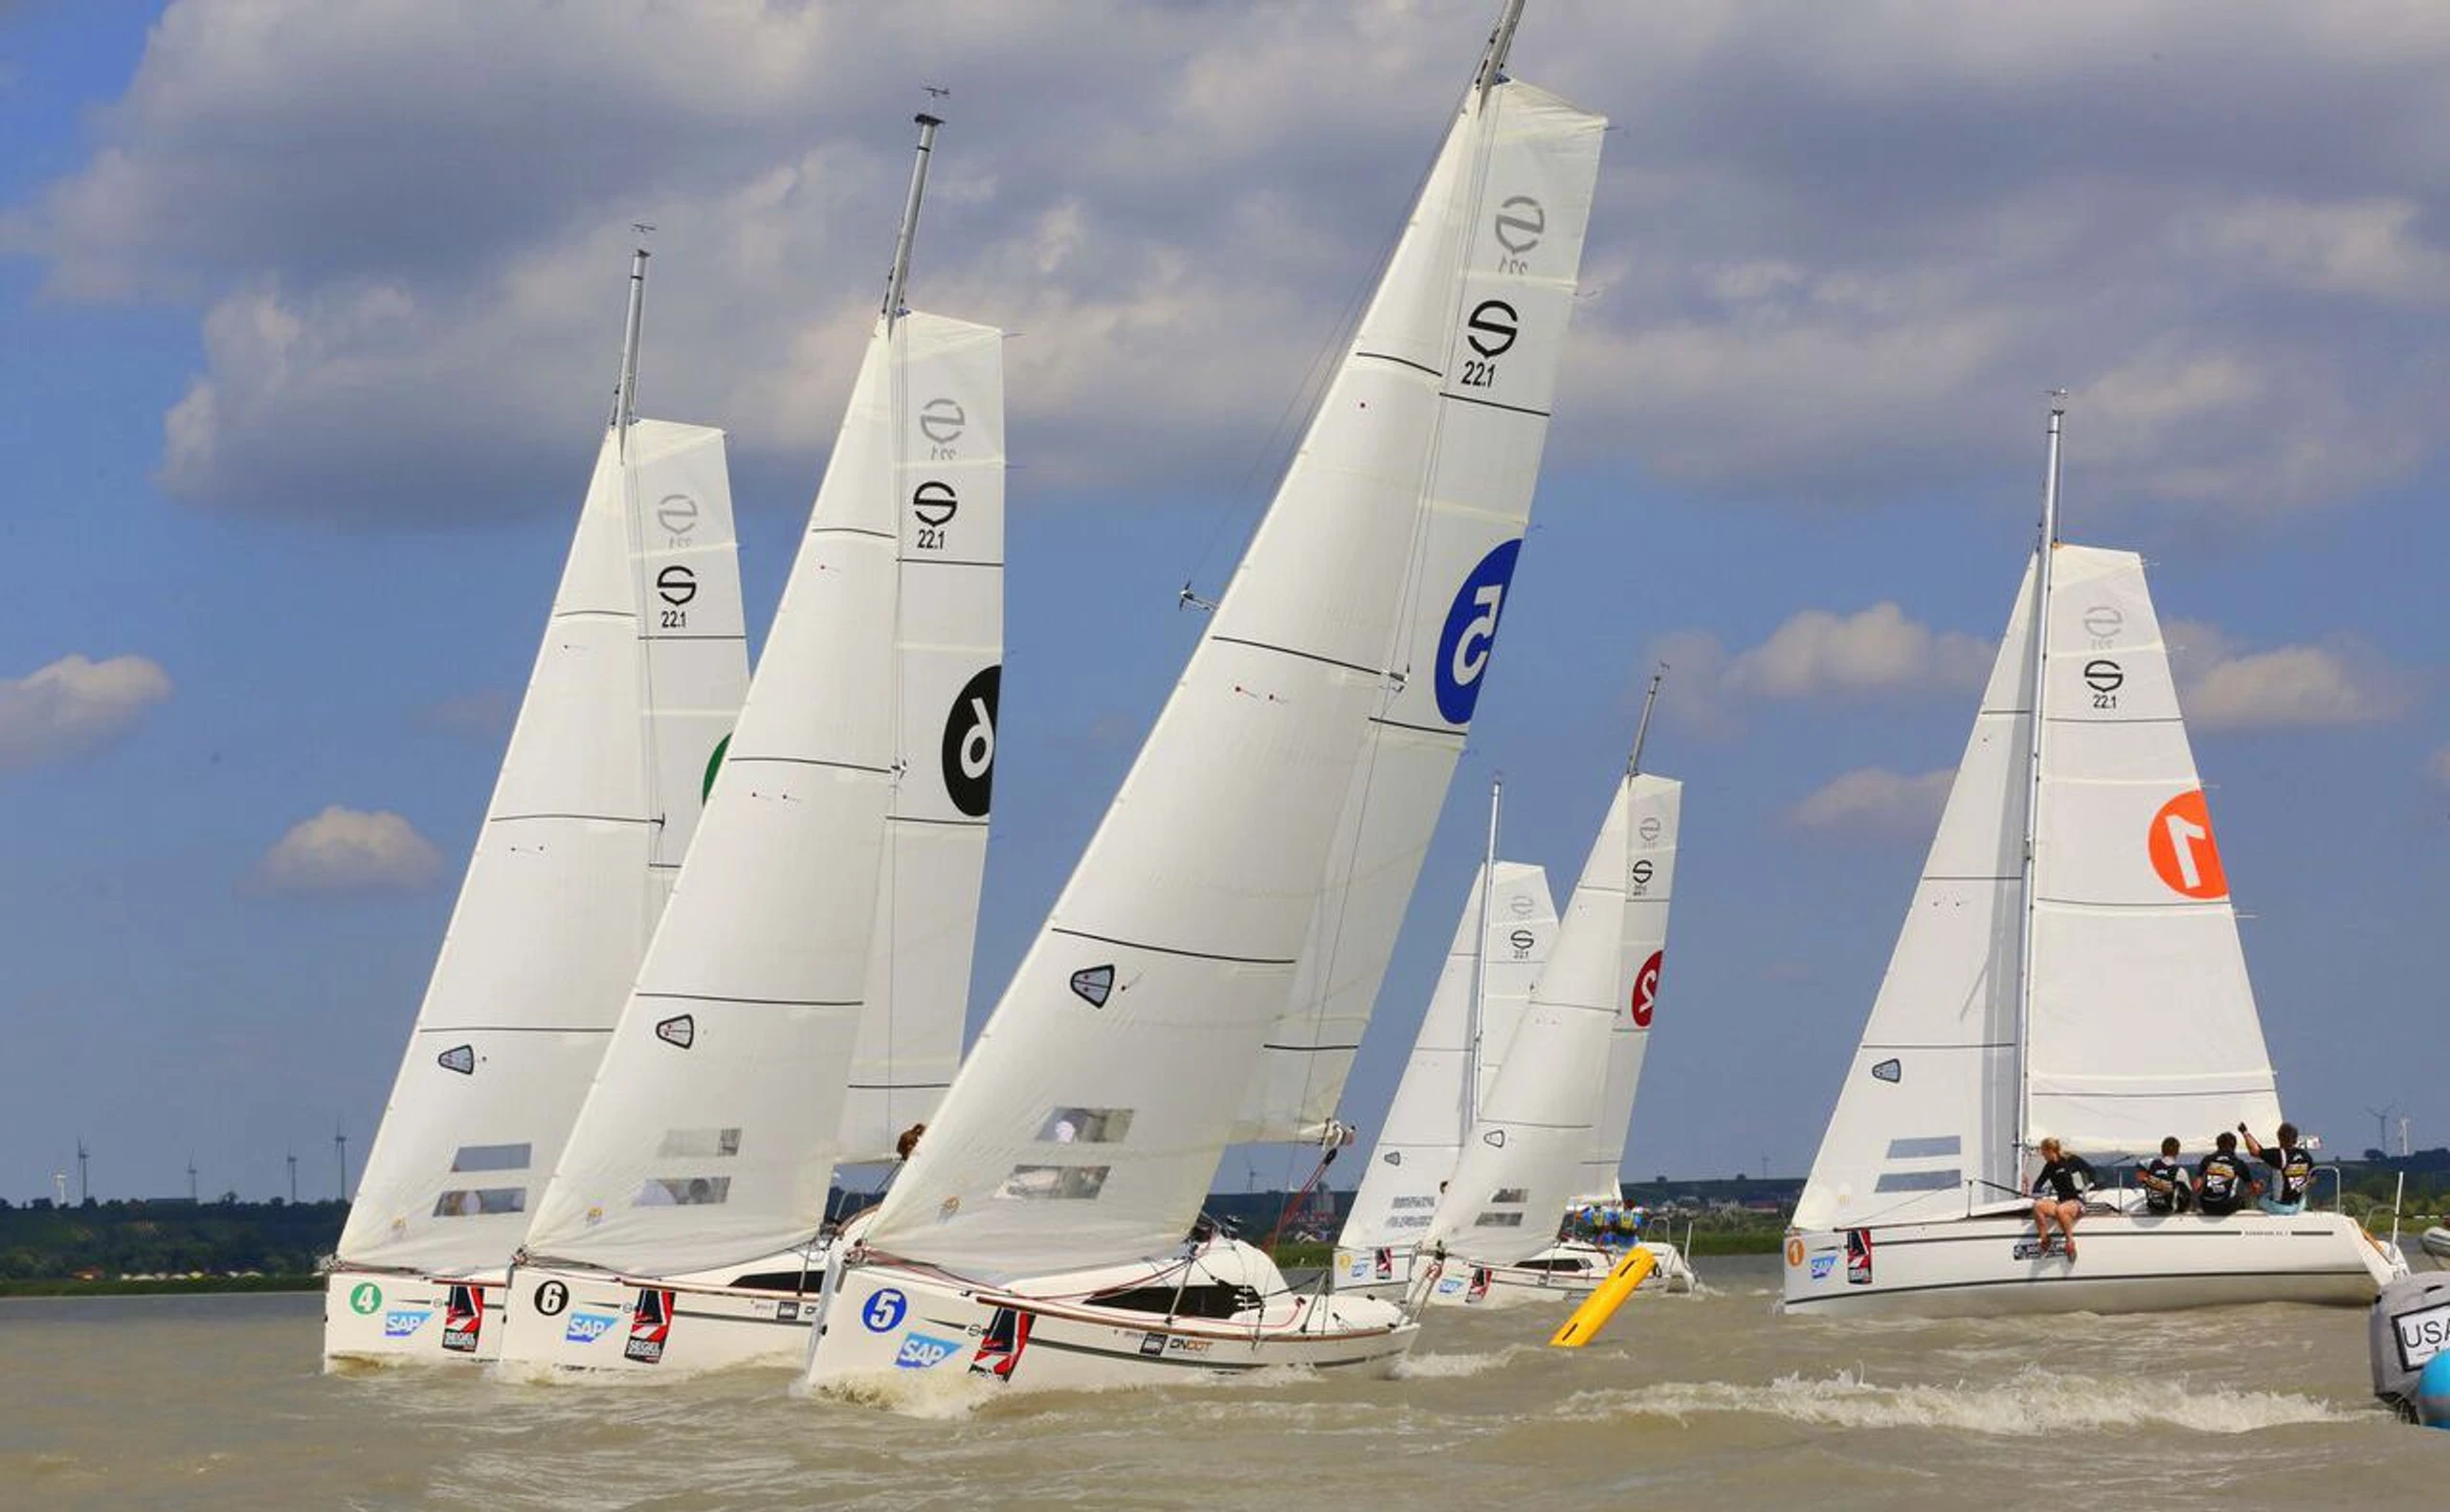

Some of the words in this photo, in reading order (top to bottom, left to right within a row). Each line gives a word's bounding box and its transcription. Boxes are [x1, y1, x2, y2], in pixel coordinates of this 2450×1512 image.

[1461, 361, 1496, 387] 22.1
[917, 529, 946, 550] 22.1
[660, 611, 687, 629] 22.1
[2093, 695, 2117, 709] 22.1
[357, 1285, 375, 1313] 4
[541, 1282, 562, 1314] 6
[869, 1292, 900, 1328] 5
[387, 1315, 421, 1332] SAP
[568, 1318, 606, 1337] SAP
[901, 1340, 947, 1366] SAP
